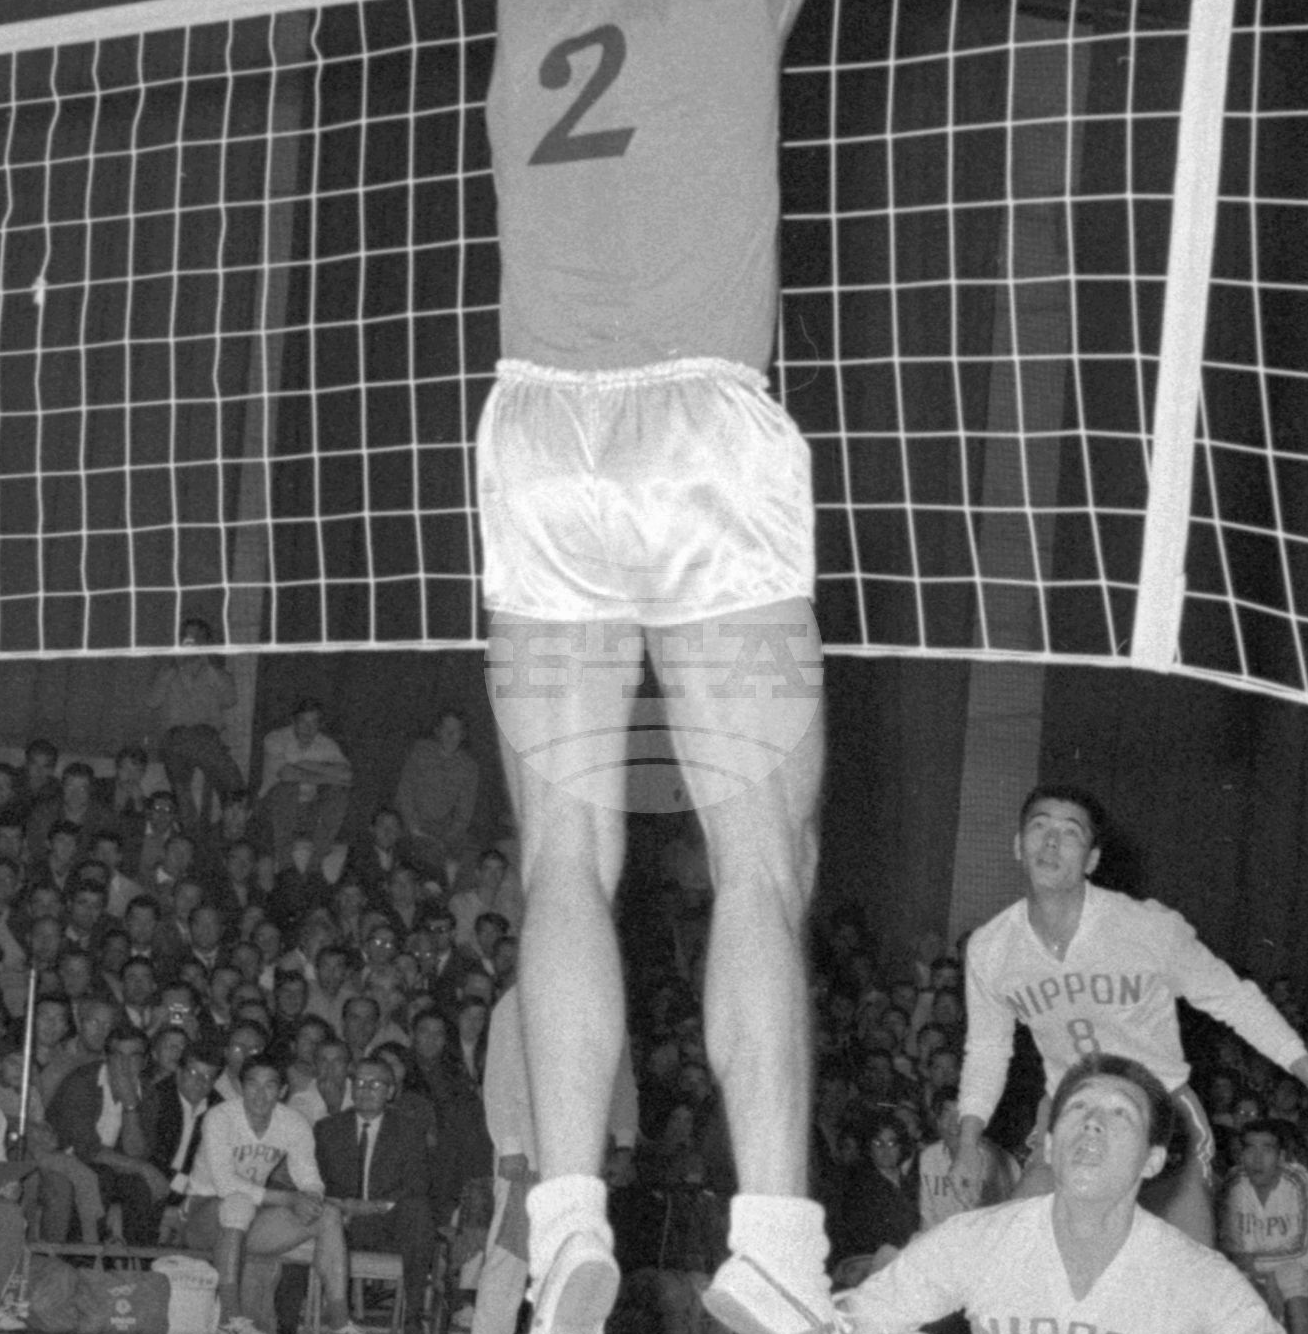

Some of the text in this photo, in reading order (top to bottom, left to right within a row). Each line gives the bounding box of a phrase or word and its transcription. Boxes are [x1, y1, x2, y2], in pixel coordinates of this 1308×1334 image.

[527, 24, 638, 166] 2
[1005, 972, 1142, 1019] NIPPON
[1067, 1018, 1101, 1060] 8
